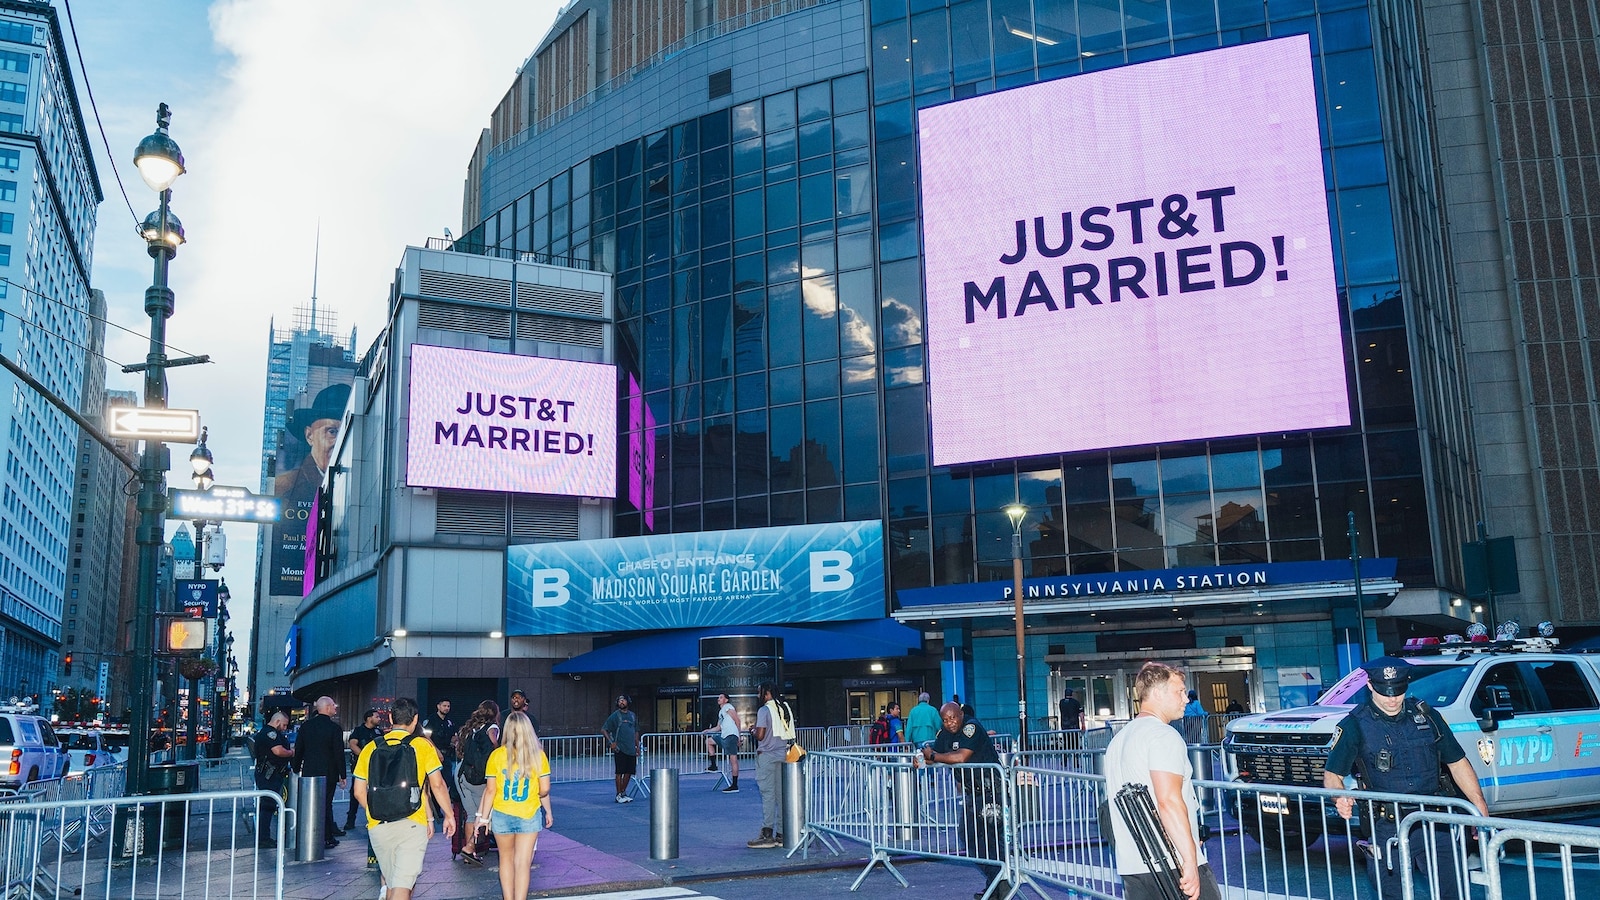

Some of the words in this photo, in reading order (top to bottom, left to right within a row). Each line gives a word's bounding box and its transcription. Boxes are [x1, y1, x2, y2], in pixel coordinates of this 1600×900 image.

[999, 186, 1236, 265] JUST&T
[964, 235, 1289, 324] MARRIED!
[457, 392, 575, 423] JUST&T
[434, 421, 594, 456] MARRIED!
[283, 533, 299, 541] Paul
[617, 560, 659, 572] CHASE
[676, 553, 755, 568] ENTRANCE
[809, 549, 855, 593] B
[532, 567, 570, 608] B
[592, 576, 655, 600] MADISON
[660, 572, 716, 598] SQUARE
[721, 568, 781, 593] GARDEN
[1003, 577, 1165, 598] PNNSYLVANIA
[1176, 571, 1267, 590] STATION
[727, 677, 752, 688] SQUARE
[1499, 733, 1554, 767] NYPD
[502, 769, 529, 802] 10
